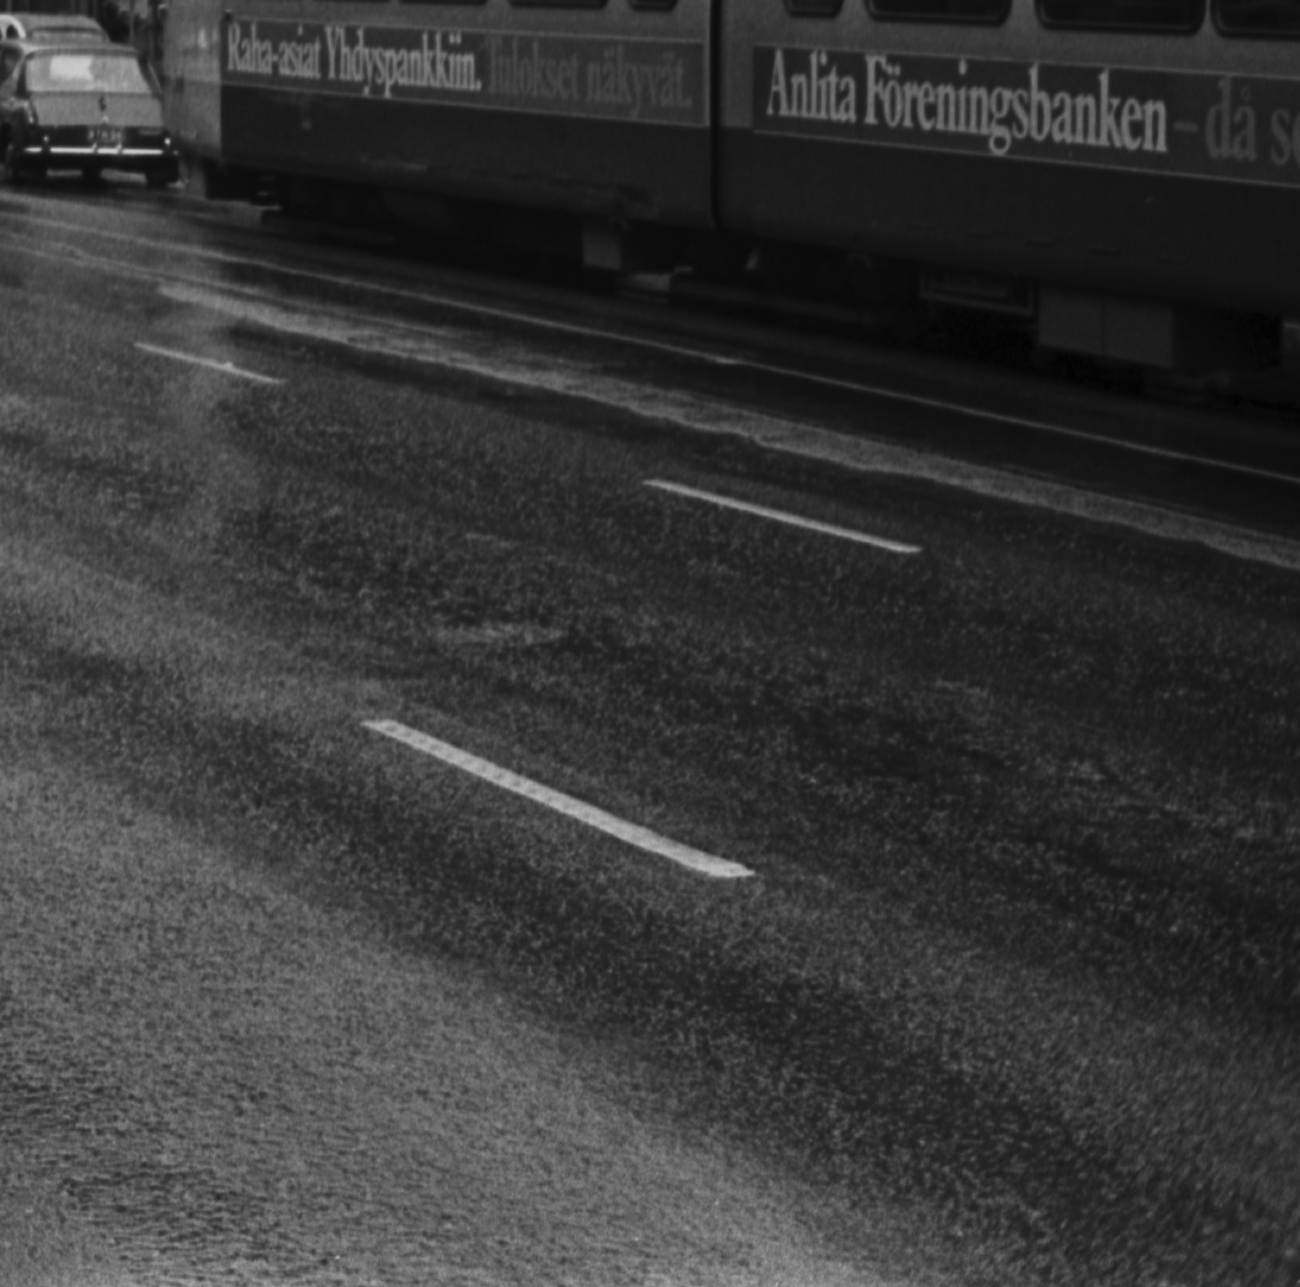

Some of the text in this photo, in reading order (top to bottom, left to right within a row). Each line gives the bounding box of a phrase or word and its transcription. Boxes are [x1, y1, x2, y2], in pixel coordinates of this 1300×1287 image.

[226, 22, 322, 81] Raha-asiat
[325, 25, 483, 99] Yhdyspankkiin.
[481, 35, 579, 101] Tulokset
[765, 48, 858, 123] Anlita
[862, 53, 1168, 156] Föreningsbanken
[1205, 76, 1258, 162] då
[1271, 108, 1300, 167] s
